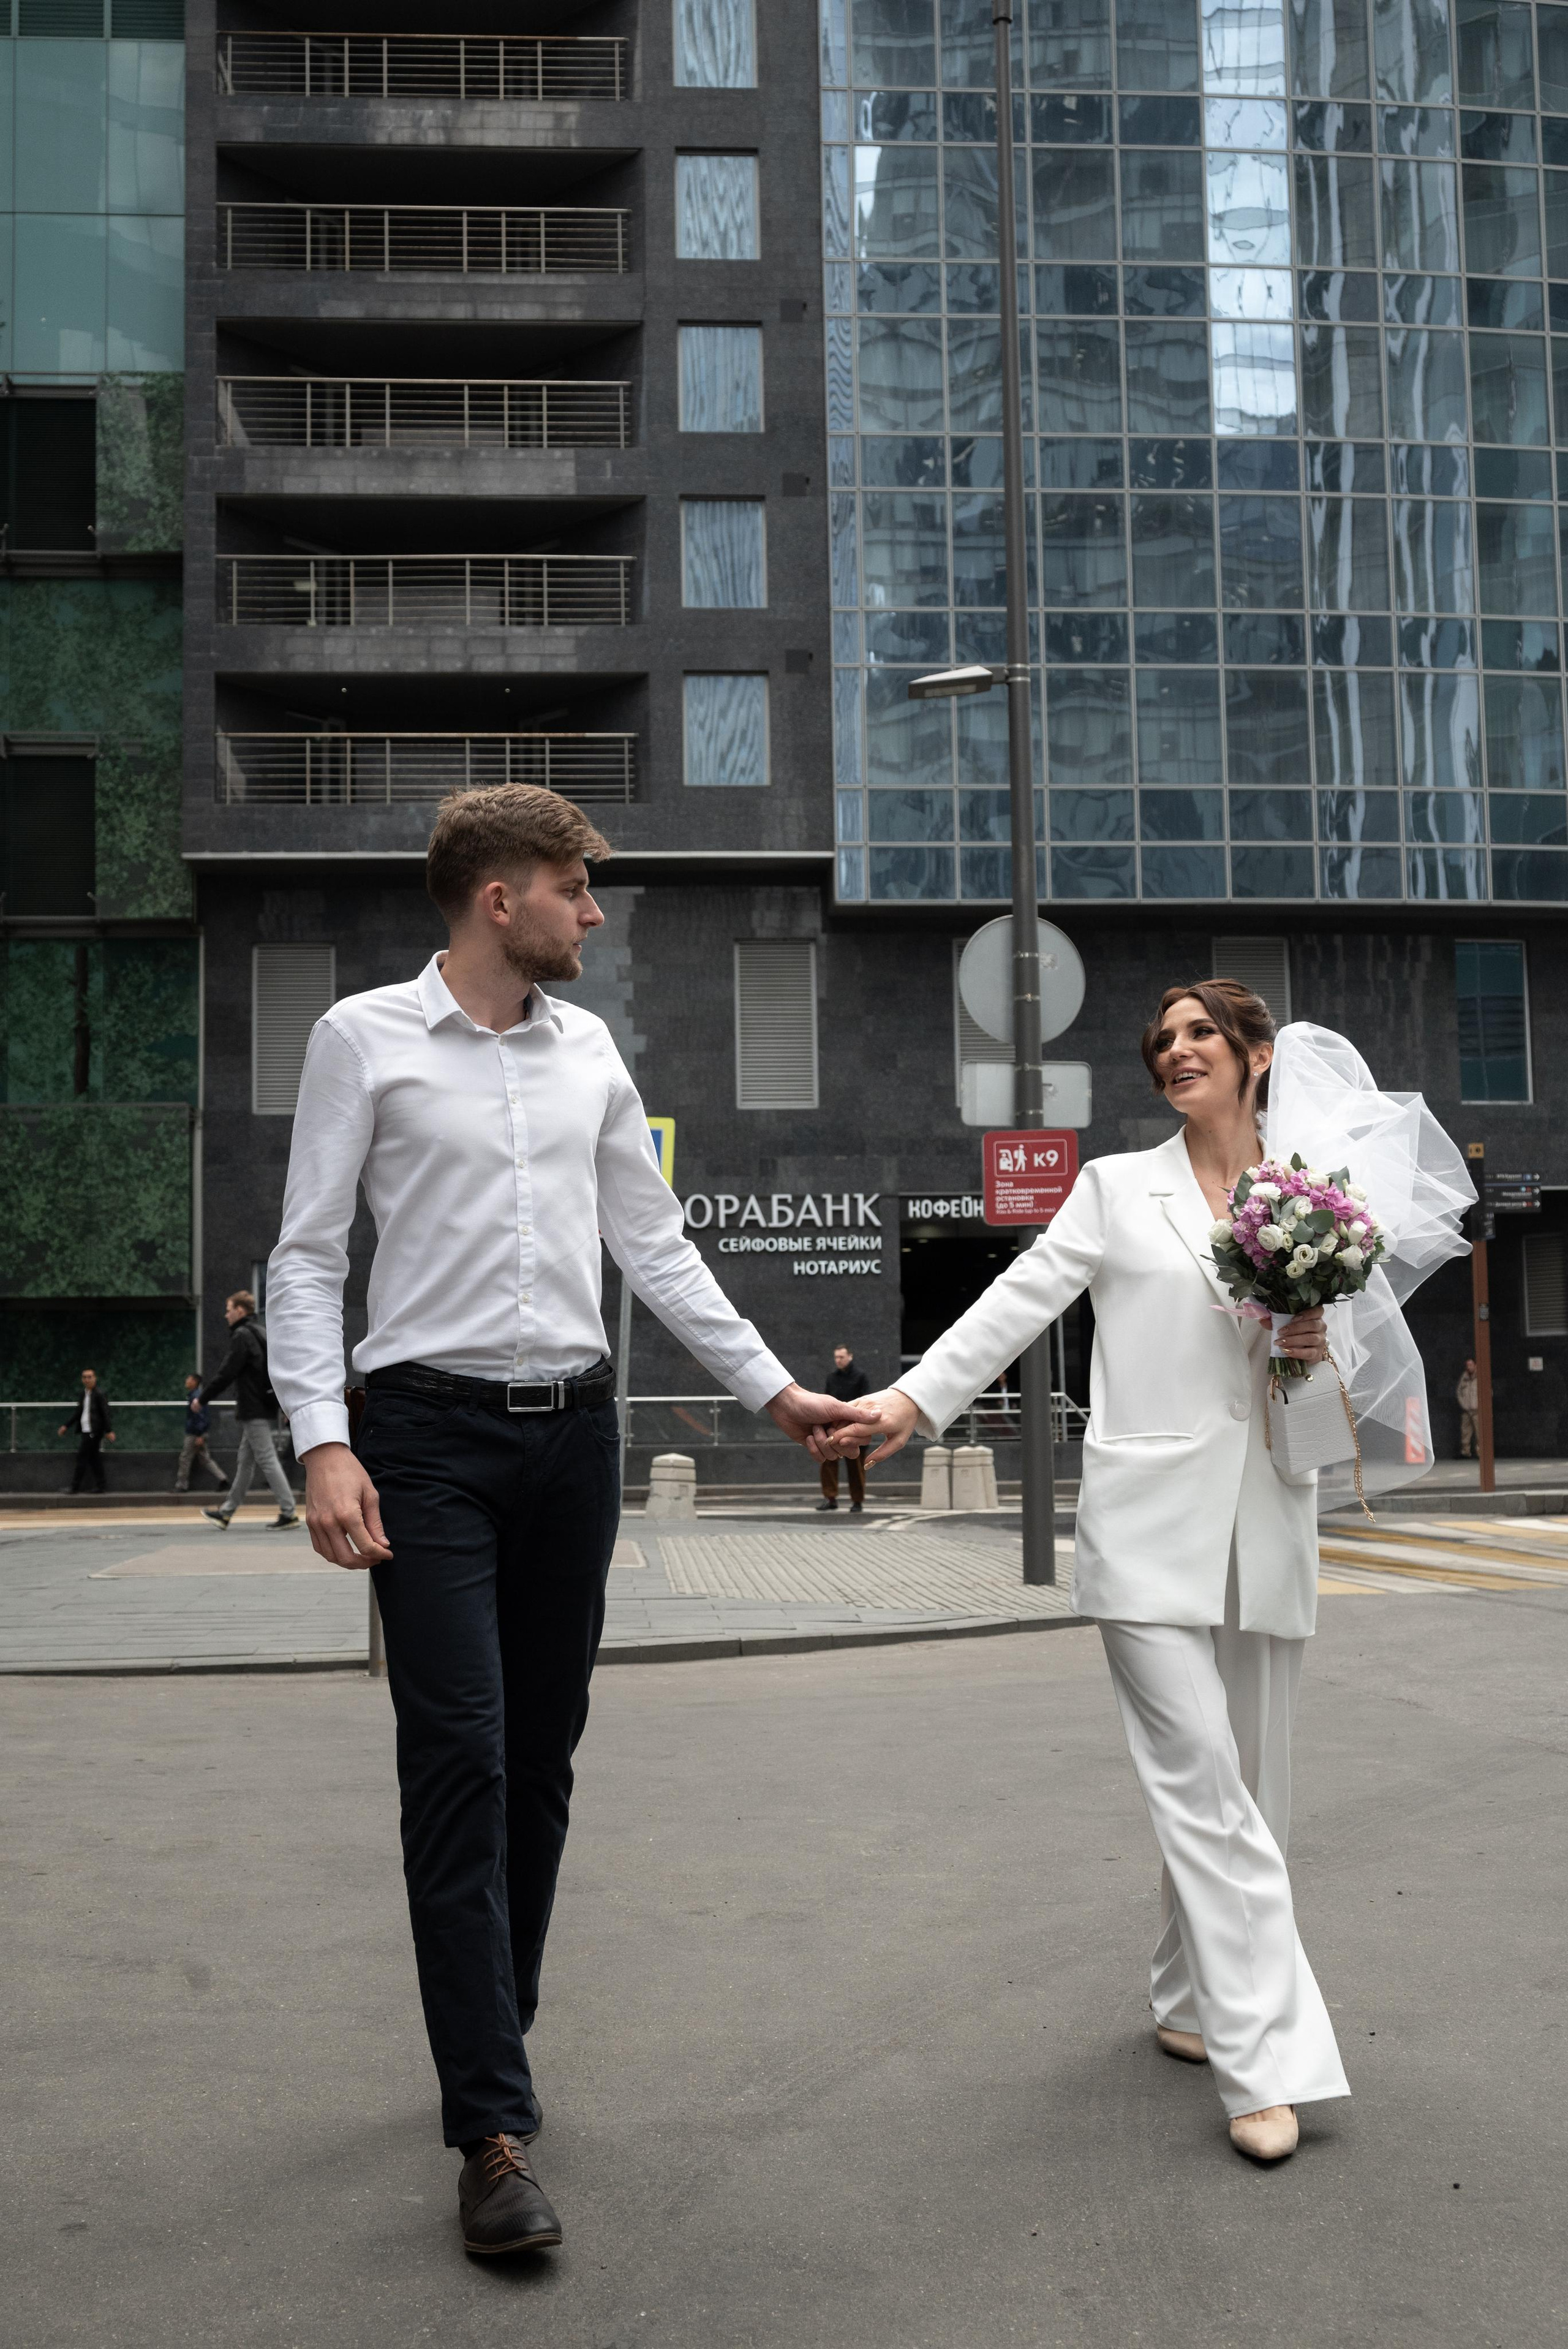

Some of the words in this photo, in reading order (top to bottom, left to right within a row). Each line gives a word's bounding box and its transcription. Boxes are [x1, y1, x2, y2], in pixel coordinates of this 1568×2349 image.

[995, 1186, 1063, 1195] кратковременной
[684, 1193, 883, 1229] ОРАБАНК
[908, 1195, 984, 1219] КОФЕЙН
[718, 1235, 813, 1253] СЕЙФОВЫЕ
[815, 1234, 883, 1252] ЯЧЕЙКИ
[793, 1259, 883, 1276] НОТАРИУС
